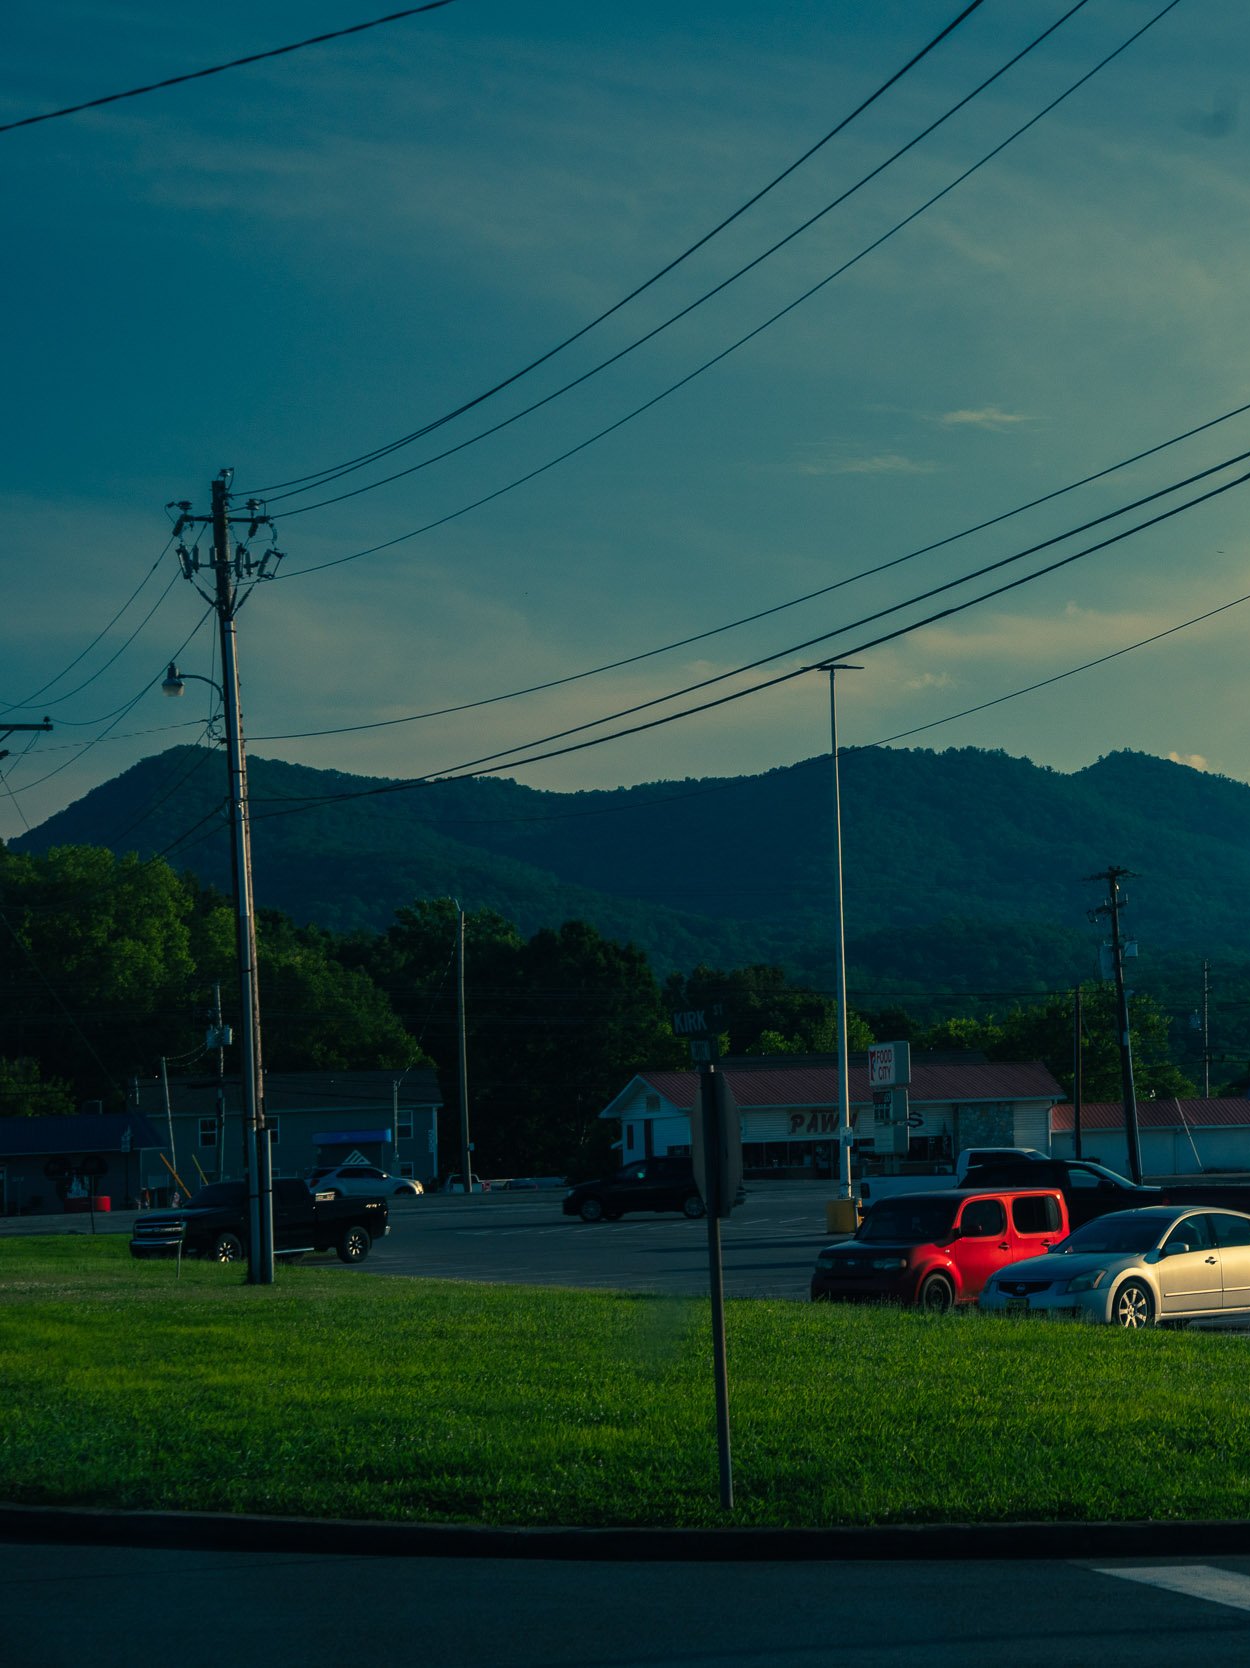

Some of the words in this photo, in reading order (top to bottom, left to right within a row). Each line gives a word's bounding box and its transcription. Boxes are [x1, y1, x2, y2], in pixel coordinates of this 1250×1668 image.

[674, 1010, 708, 1034] KIRK
[712, 1003, 722, 1017] ST
[876, 1049, 893, 1064] FOOD
[878, 1065, 892, 1081] CITY
